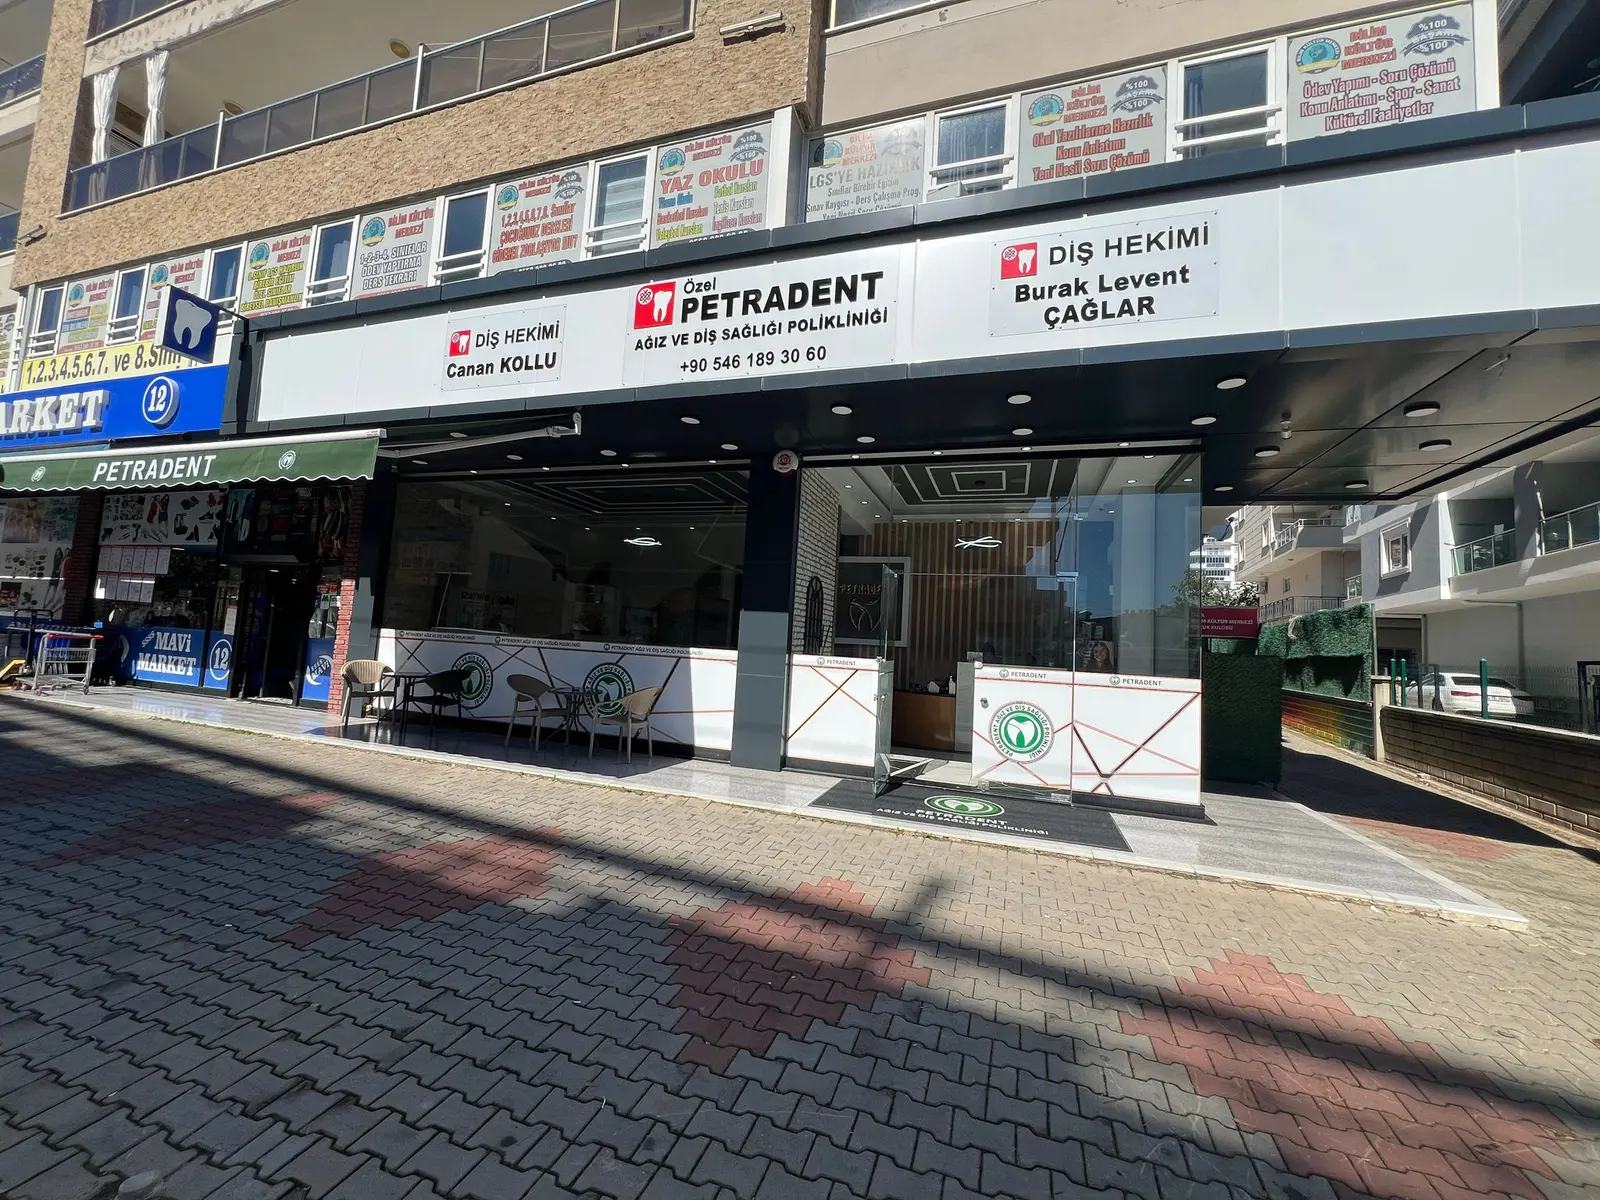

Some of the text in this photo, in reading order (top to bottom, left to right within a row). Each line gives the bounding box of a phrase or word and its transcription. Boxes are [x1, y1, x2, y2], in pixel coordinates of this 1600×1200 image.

[1419, 19, 1448, 31] %100
[1419, 41, 1448, 52] %100
[1126, 80, 1148, 90] %100
[1303, 58, 1456, 99] Ödev Yapımı Soru Çözümü
[1125, 100, 1148, 110] %100
[1300, 76, 1460, 118] Konu Anlatımı Spor Sanat
[1324, 101, 1434, 132] Kültürel Faaliyetler
[741, 134, 757, 143] %100
[1032, 112, 1154, 148] Okul Yazılılarına Hazırlık
[1056, 138, 1126, 161] Konu Anlatımı
[660, 159, 763, 194] YAZ OKULU
[1032, 150, 1150, 182] Yeni Nesil Soru Çözümü
[714, 179, 758, 198] Futbol Kursları
[854, 182, 875, 193] Birebir
[713, 196, 754, 215] Tenis Kursları
[806, 188, 921, 213] Sınav Kaygısı Ders Çalışma Prog.
[541, 214, 573, 237] DERSLERİ
[680, 222, 704, 237] Kursları
[738, 212, 762, 227] Kursları
[360, 241, 427, 265] 1-2-3-4. SINIFLAR
[562, 234, 578, 250] MU?
[1048, 221, 1209, 266] DİŞ HEKİMİ
[362, 256, 422, 277] ÖDEV YAPTIRMA
[362, 270, 417, 290] DERS TEKRARI
[684, 277, 717, 294] Özel
[1015, 264, 1190, 303] Burak Levent
[680, 271, 884, 323] PETRADENT
[1044, 295, 1155, 330] ÇAĞLAR
[475, 320, 560, 349] DİŞ HEKİMİ
[634, 307, 888, 351] AĞIZ VE DİŞ SAĞLIĞI POLİKLİNİĞİ
[26, 351, 130, 385] 1.2.3.4.5.6.7. ve
[446, 352, 557, 378] Canan KOLLU
[680, 345, 826, 373] +90 546 189 30 60
[148, 384, 167, 412] 12
[93, 455, 216, 482] PETRADENT
[136, 652, 196, 676] MARKET
[214, 647, 229, 670] 12
[1011, 671, 1047, 679] PETRADENT
[1122, 678, 1162, 686] PETRADENT
[993, 724, 1013, 757] PETRADENT
[915, 809, 1008, 826] PETRADENT
